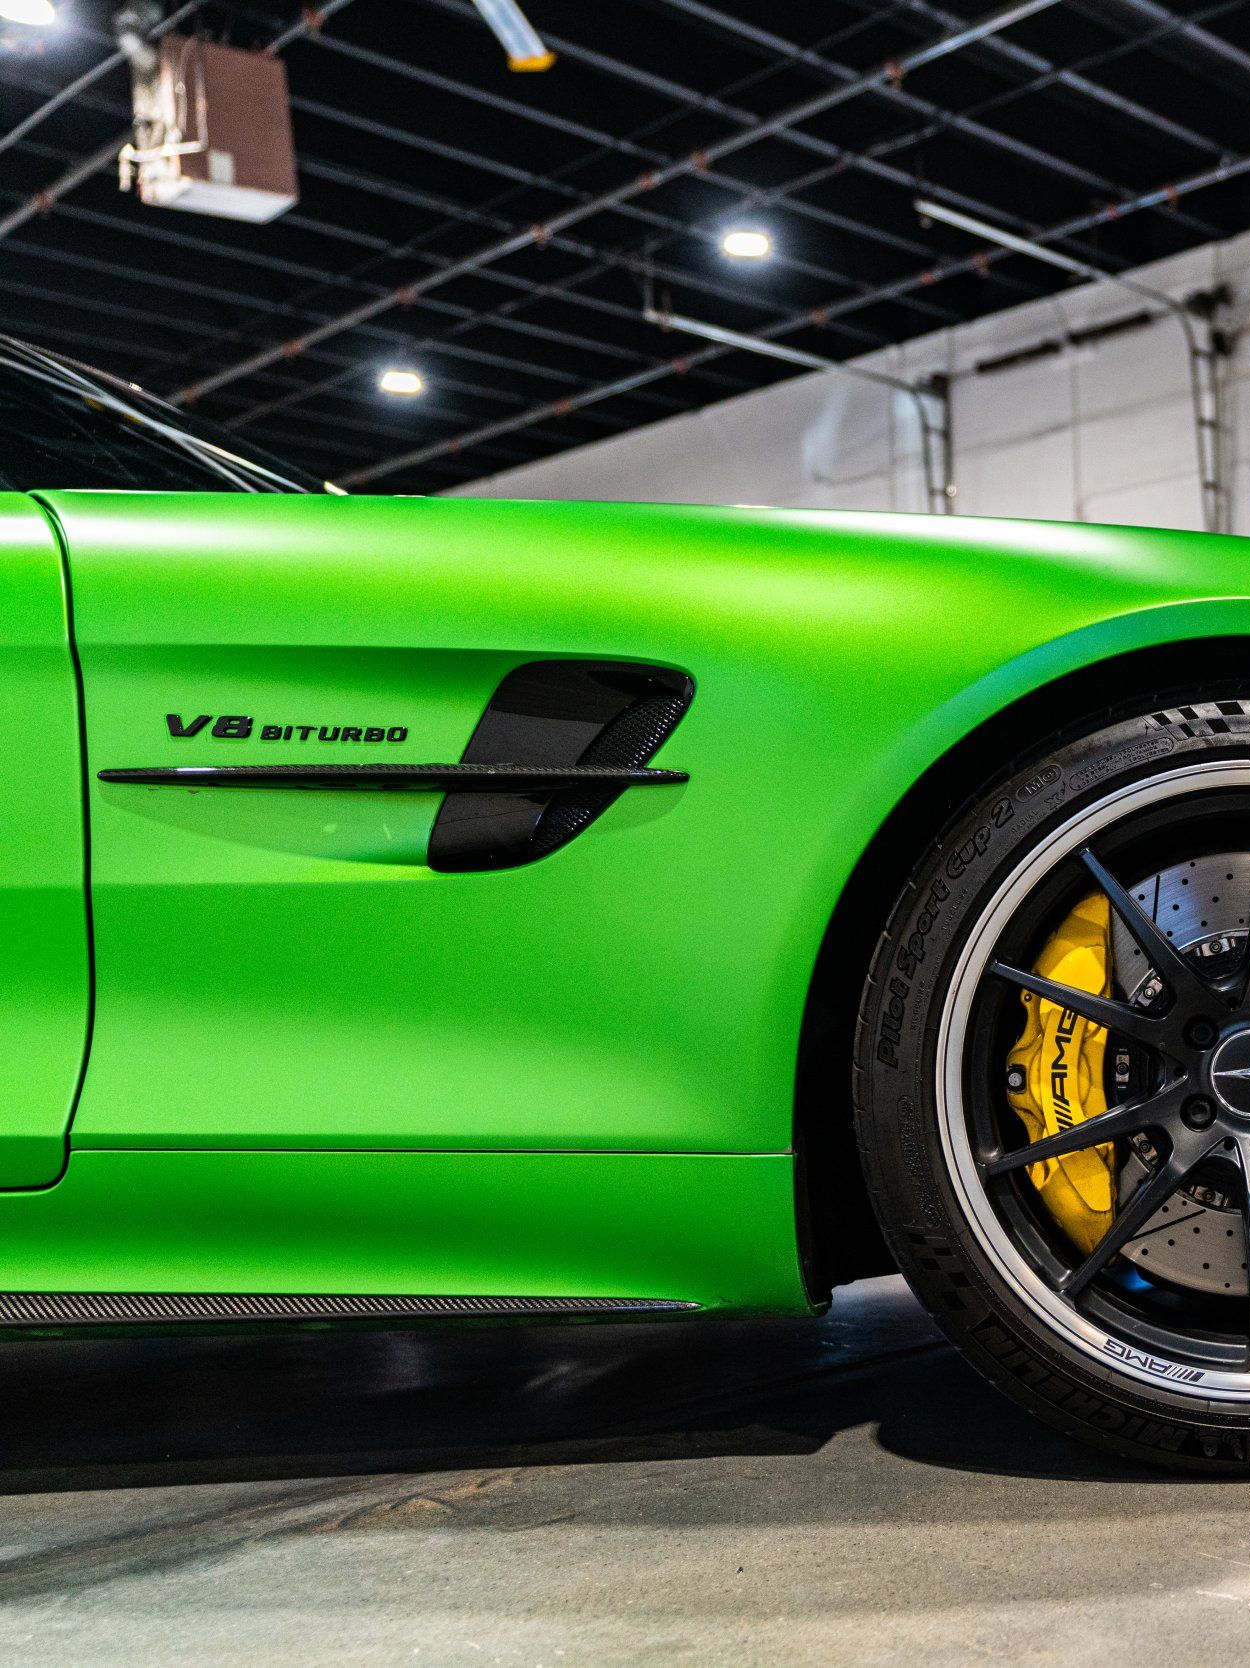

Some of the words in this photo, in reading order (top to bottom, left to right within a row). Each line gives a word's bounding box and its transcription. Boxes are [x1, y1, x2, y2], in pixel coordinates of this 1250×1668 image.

[166, 714, 253, 738] V8
[260, 725, 408, 742] BITURBO
[897, 877, 950, 980] Sport
[946, 823, 992, 880] Cup
[991, 796, 1015, 829] 2
[1051, 1006, 1079, 1107] AMG
[973, 1325, 1191, 1451] MICHELIN
[1102, 1338, 1172, 1377] AMG
